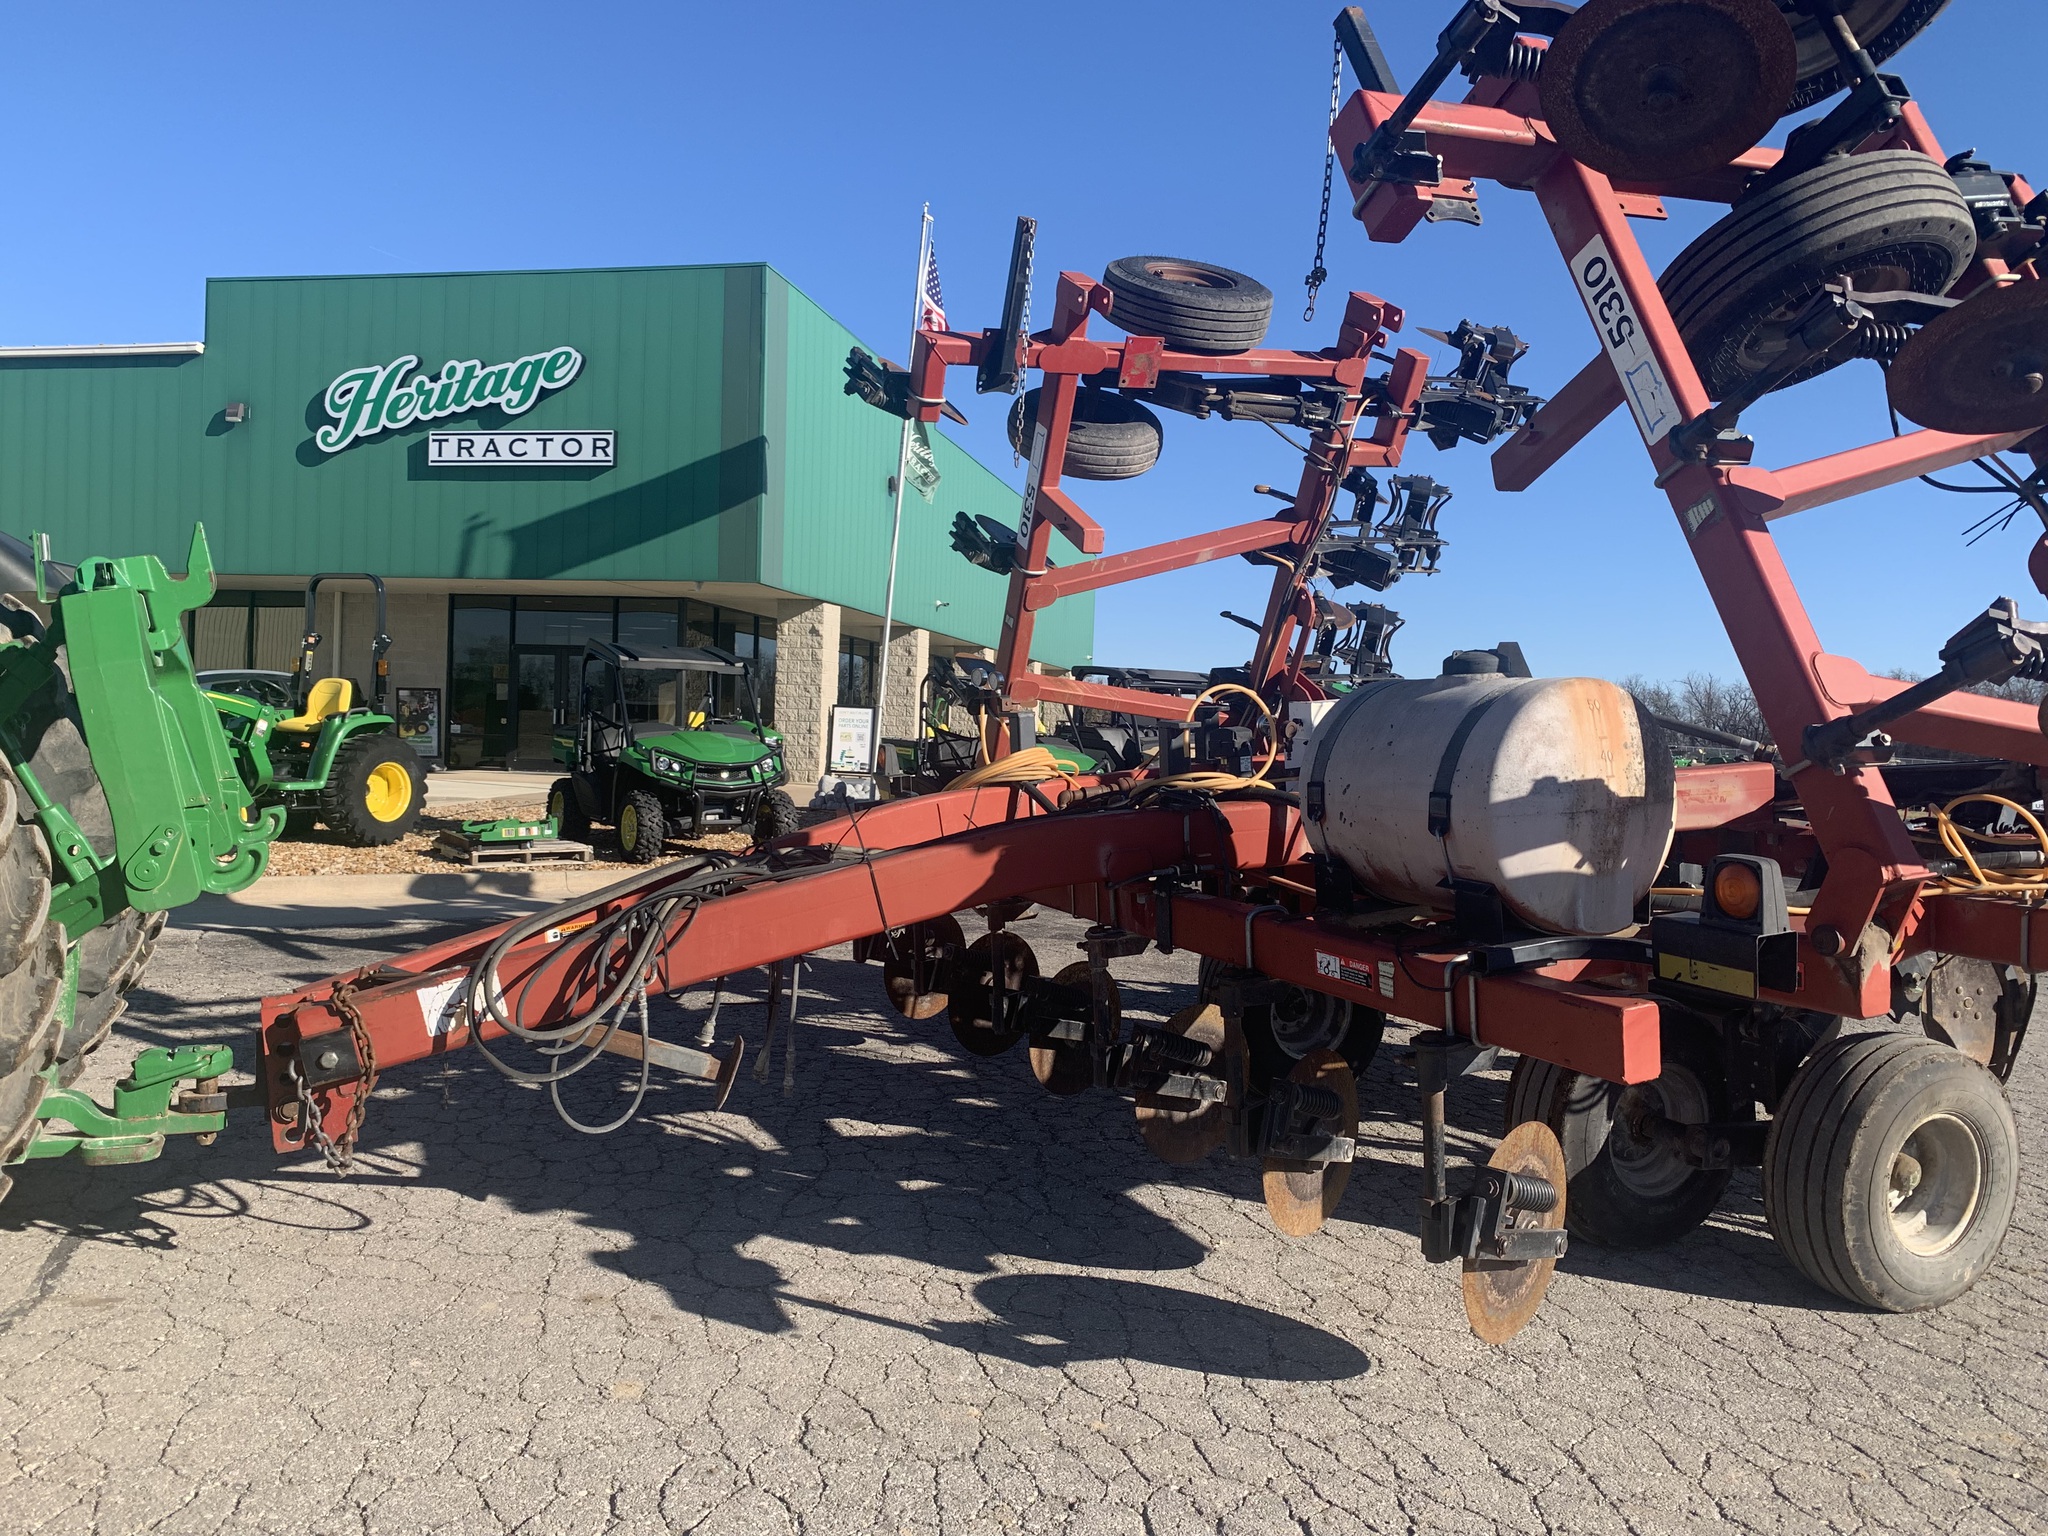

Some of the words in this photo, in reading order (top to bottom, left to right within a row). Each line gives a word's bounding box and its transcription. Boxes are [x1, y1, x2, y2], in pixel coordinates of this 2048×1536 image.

[1583, 256, 1635, 349] 5310
[318, 346, 582, 452] Heritage
[431, 437, 612, 458] TRACTOR
[1020, 482, 1036, 538] 5310
[565, 922, 594, 930] WARNING
[1349, 960, 1370, 972] DANGER
